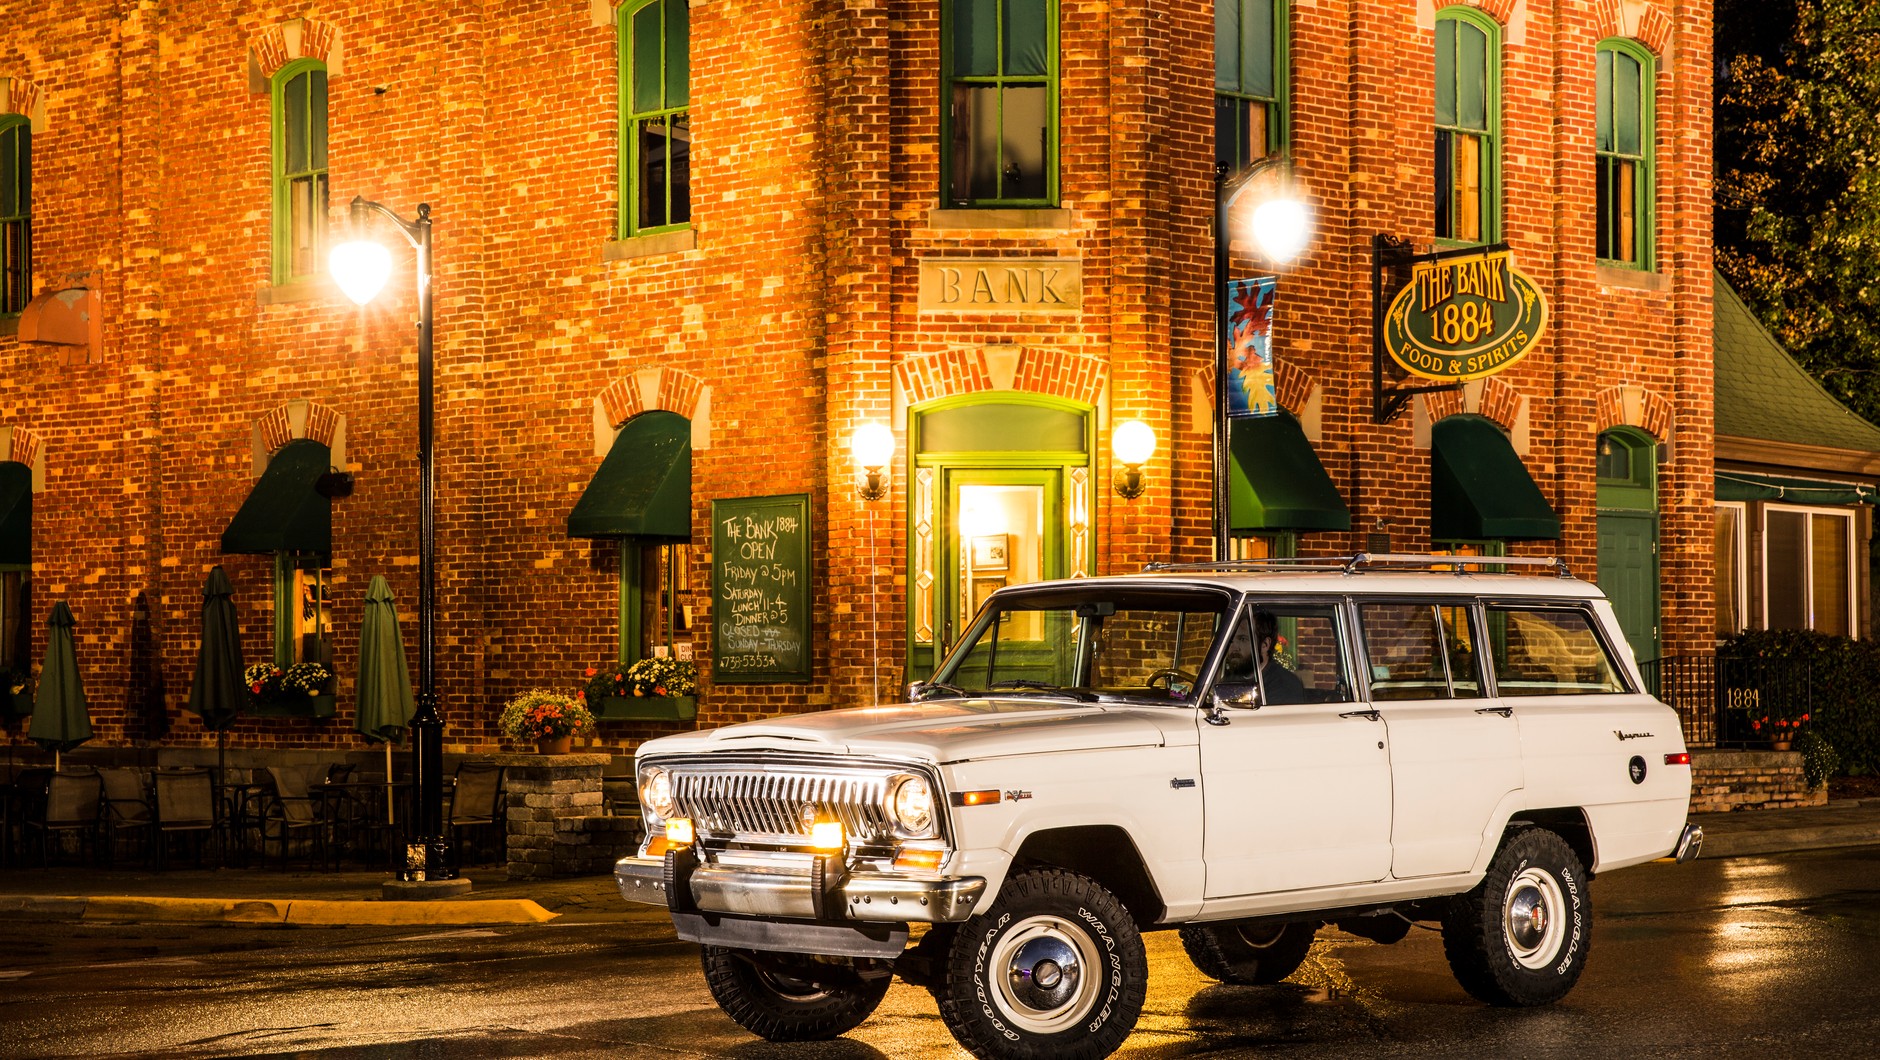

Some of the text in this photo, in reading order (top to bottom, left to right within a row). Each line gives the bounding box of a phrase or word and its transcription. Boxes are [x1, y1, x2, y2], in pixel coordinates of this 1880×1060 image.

[938, 267, 1066, 304] BANK
[1418, 258, 1506, 312] THE BANK
[1430, 301, 1493, 344] 1884
[1400, 329, 1528, 374] FOOD & SPIRITS
[744, 516, 778, 540] BANK
[776, 516, 799, 534] 1884
[740, 540, 777, 560] OPEN
[723, 561, 758, 585] FRIDAY
[722, 582, 763, 604] SATURDAY
[731, 601, 760, 613] LUNCH
[731, 612, 770, 626] DINNER
[722, 622, 760, 637] CLOSED
[1726, 687, 1759, 709] 1884
[1557, 867, 1582, 975] WRANGLER
[974, 913, 1020, 1041] GOODYEAR
[1078, 907, 1122, 1032] WRANGLER
